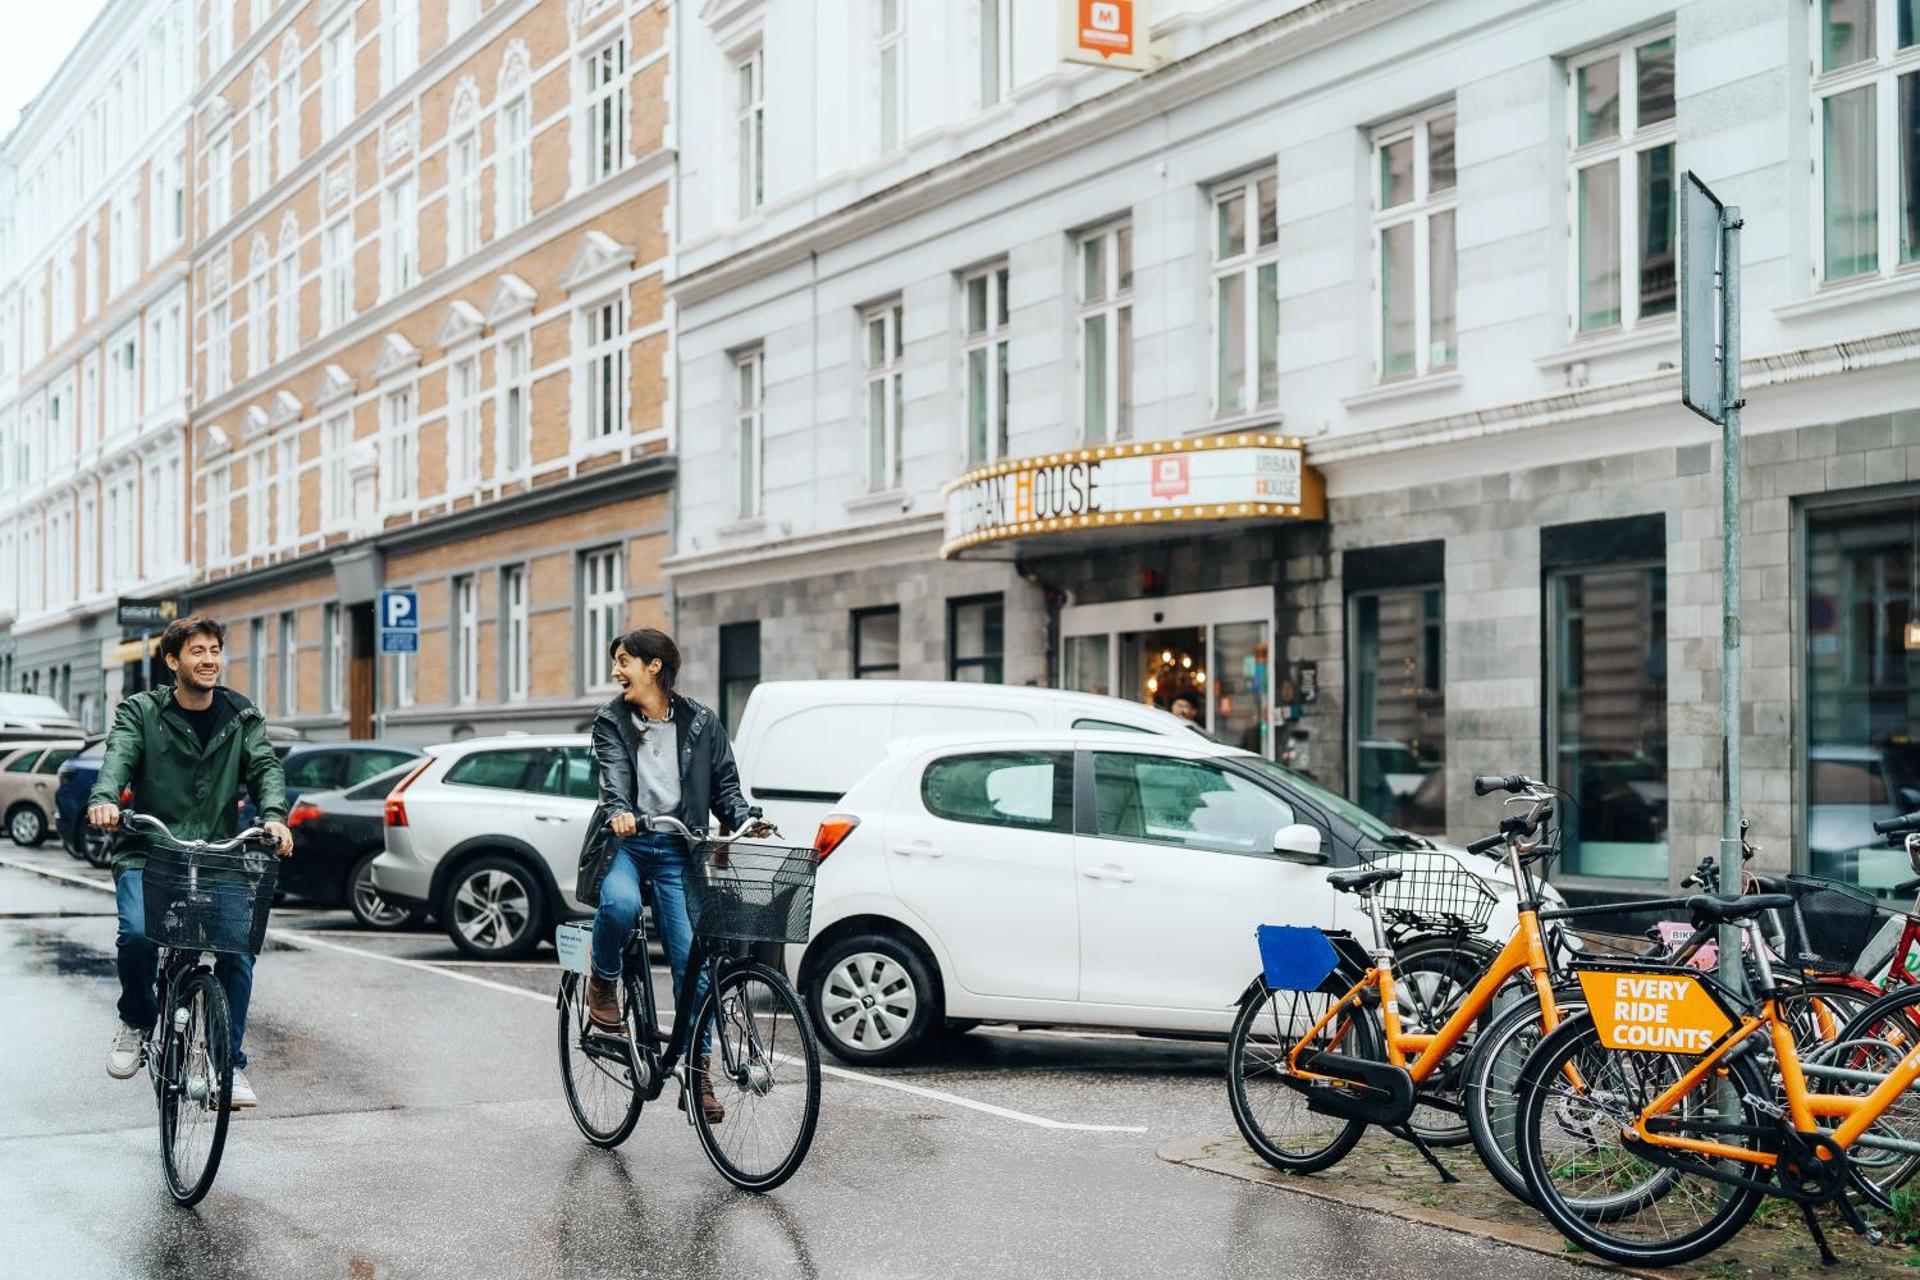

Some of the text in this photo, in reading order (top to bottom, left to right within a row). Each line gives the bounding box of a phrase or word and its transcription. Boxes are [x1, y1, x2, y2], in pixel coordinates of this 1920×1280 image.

[1256, 455, 1296, 473] URBAN
[1015, 463, 1102, 524] HOUSE
[1256, 478, 1296, 496] HOUSE
[388, 595, 411, 627] P
[1615, 977, 1691, 1001] EVERY
[1614, 1001, 1669, 1024] RIDE
[1612, 1024, 1713, 1050] COUNTS
